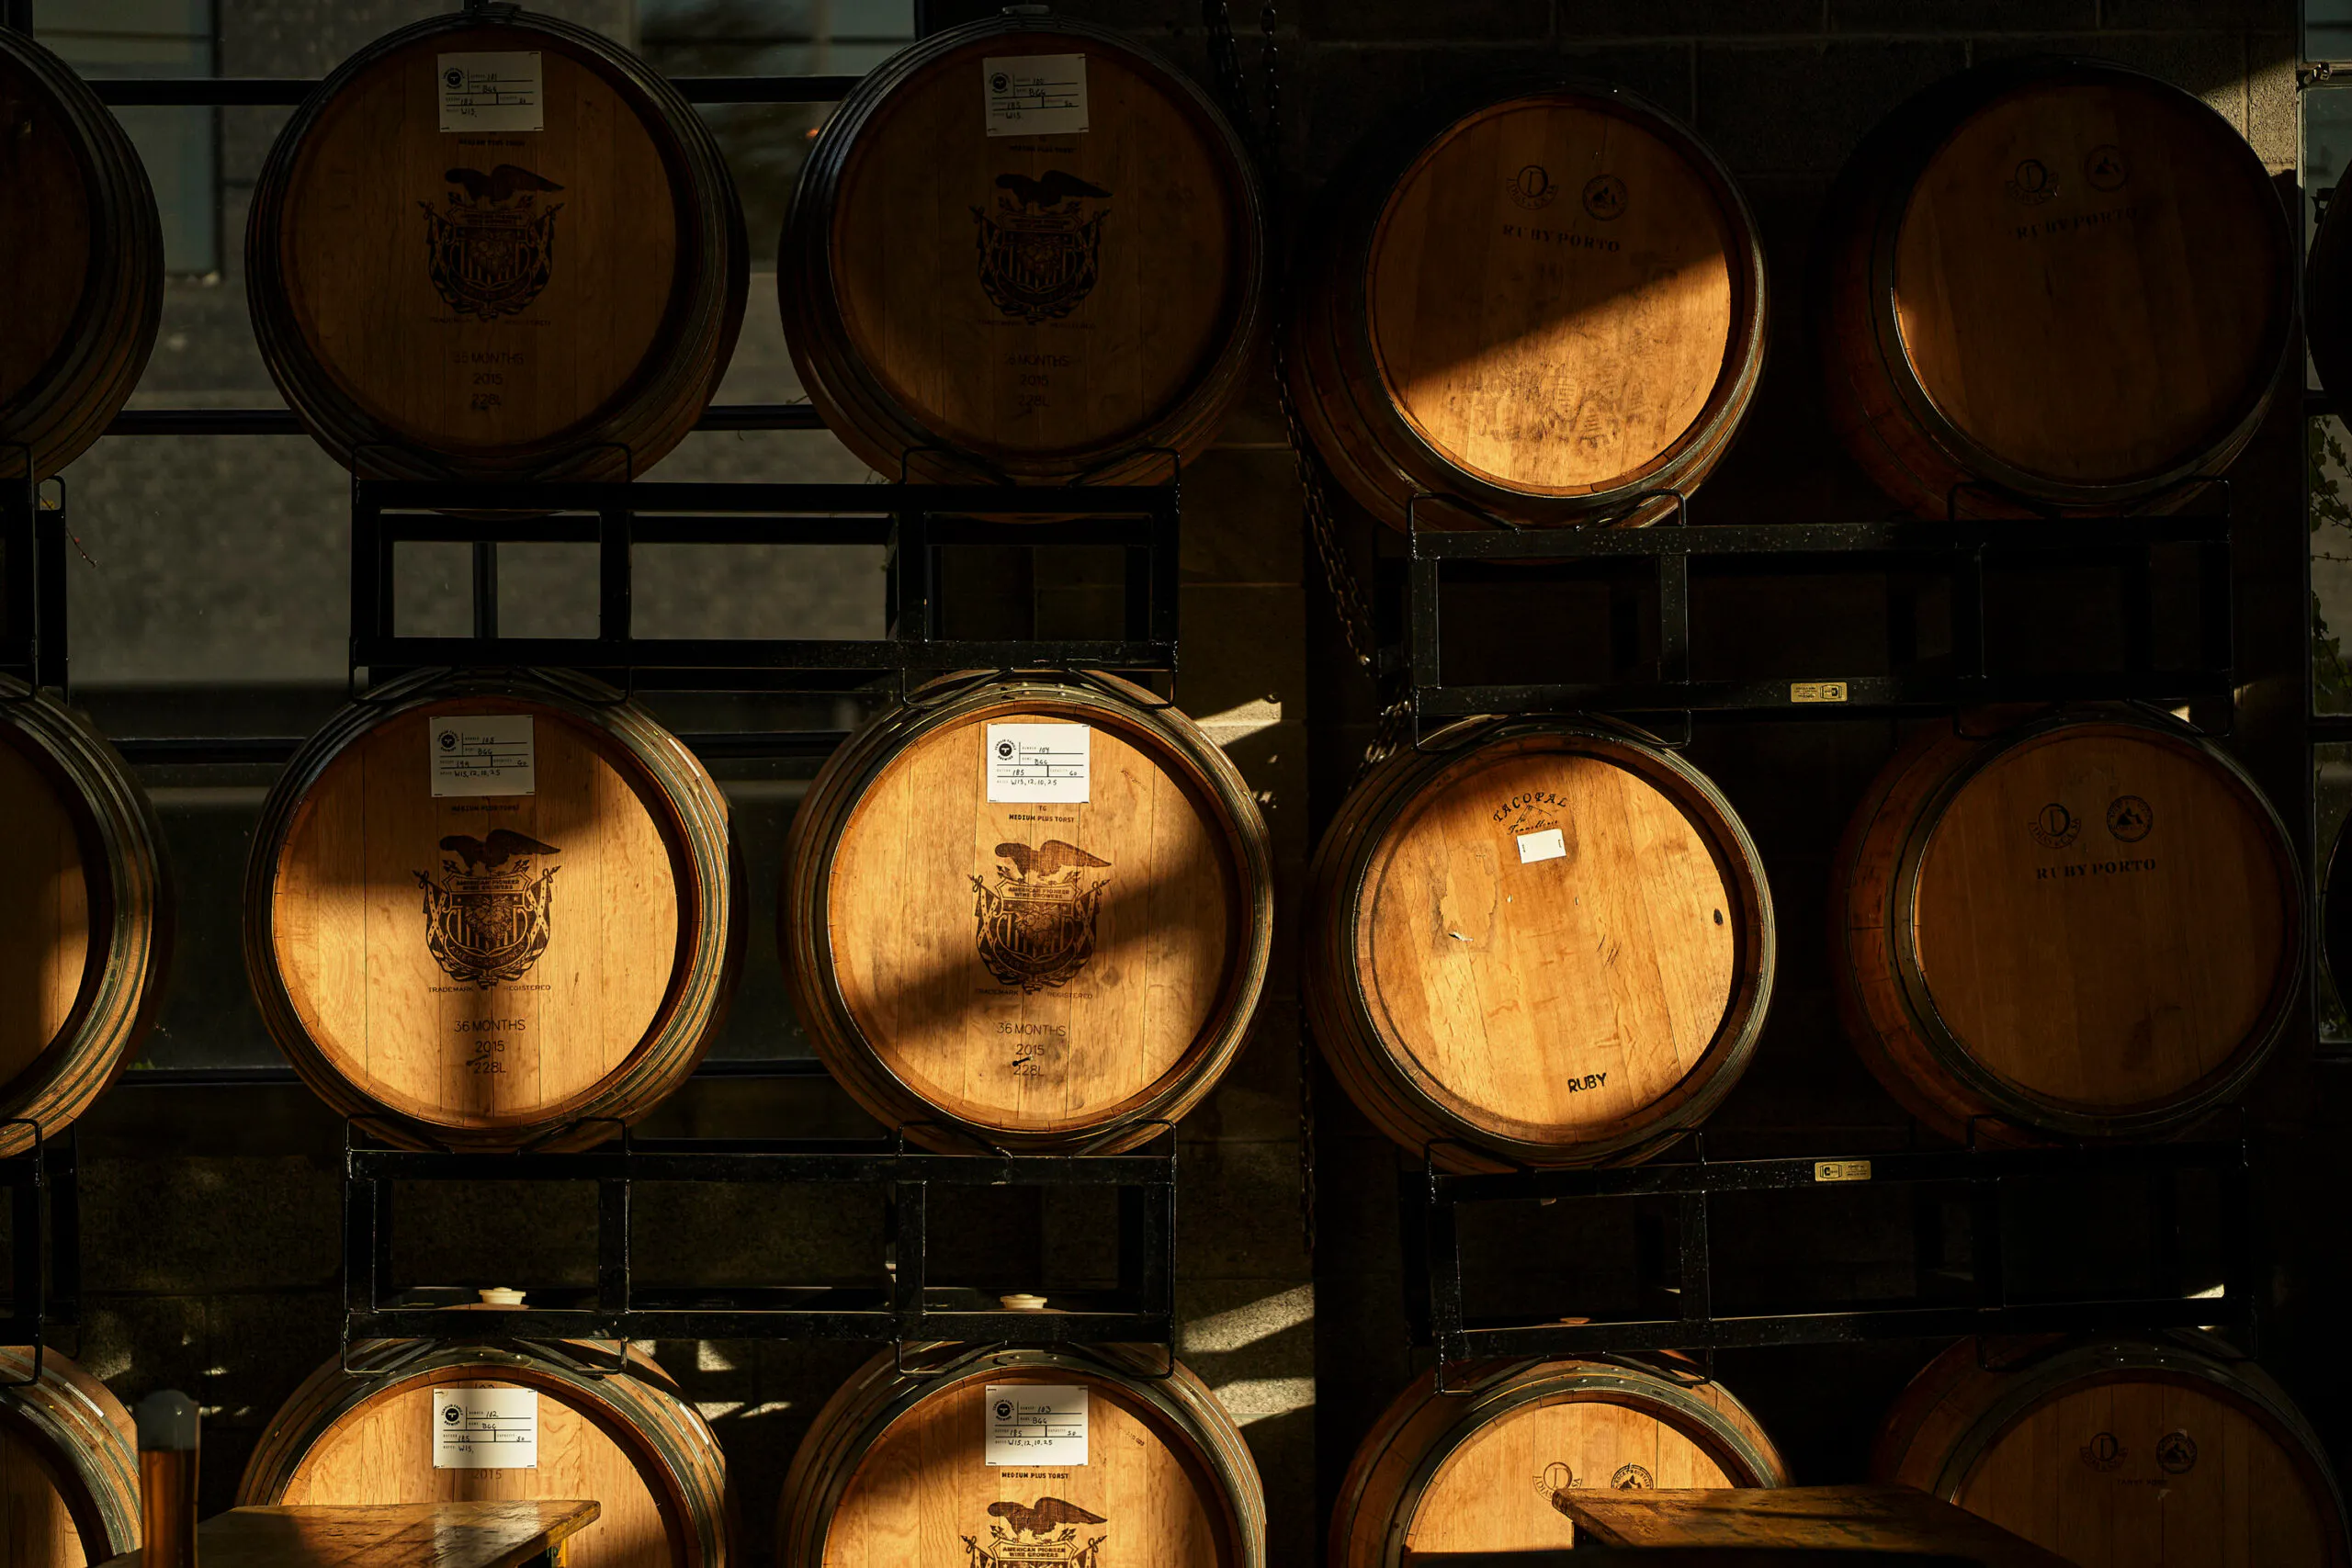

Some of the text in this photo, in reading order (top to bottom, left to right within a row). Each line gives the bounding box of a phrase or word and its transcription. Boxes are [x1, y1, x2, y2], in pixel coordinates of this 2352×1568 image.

[471, 351, 525, 366] MONTHS
[1017, 354, 1070, 367] MONTHS
[472, 372, 504, 386] 2015
[1019, 373, 1050, 387] 2015
[1018, 394, 1052, 408] 228L
[1493, 792, 1567, 822] TACOPAL
[2036, 858, 2156, 880] RUBY PORTO
[454, 1019, 526, 1032] 36 MONTHS
[997, 1021, 1067, 1037] 36 MONTHS
[475, 1040, 505, 1053] 2015
[1015, 1043, 1045, 1055] 2015
[473, 1061, 506, 1074] 228L
[1013, 1064, 1045, 1077] 228L
[1567, 1072, 1607, 1093] RUBY
